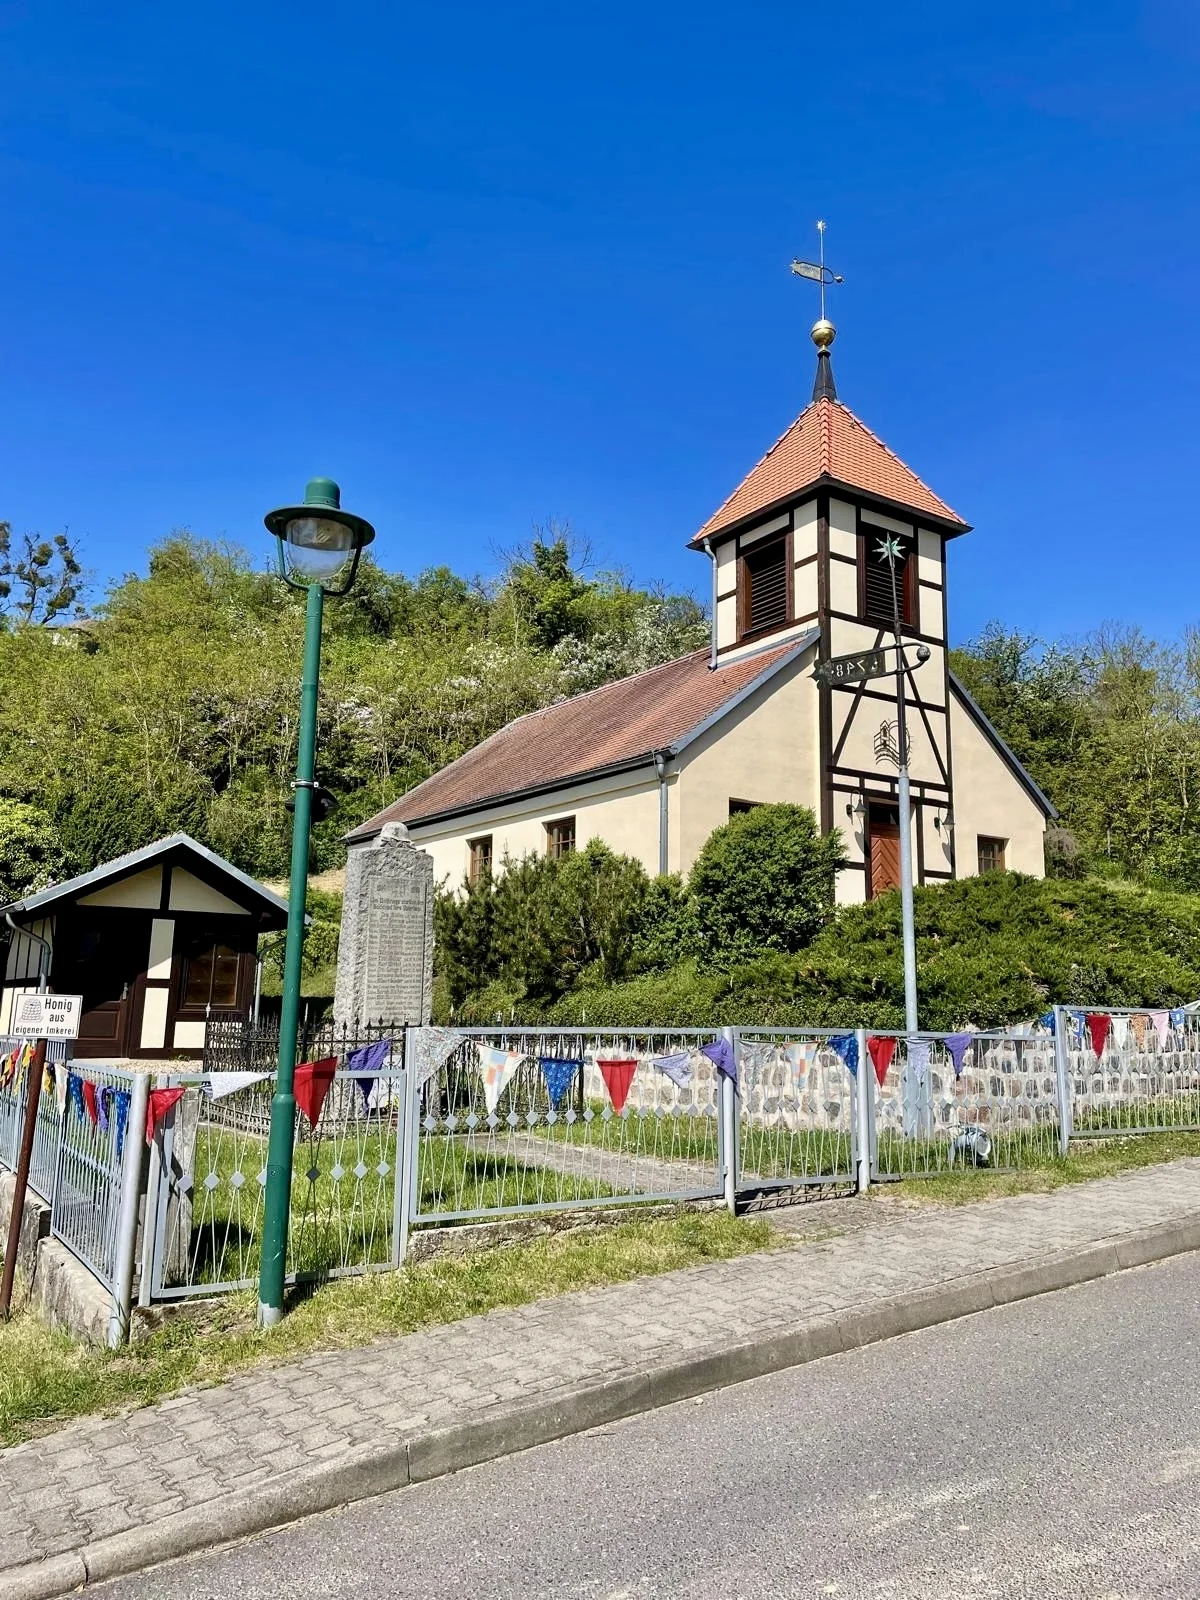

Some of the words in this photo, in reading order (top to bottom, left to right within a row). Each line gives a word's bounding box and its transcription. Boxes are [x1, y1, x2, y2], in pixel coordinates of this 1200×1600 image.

[44, 998, 72, 1012] Honig
[49, 1014, 65, 1022] aus
[15, 1026, 43, 1034] eigener
[46, 1026, 75, 1035] Imkerei
